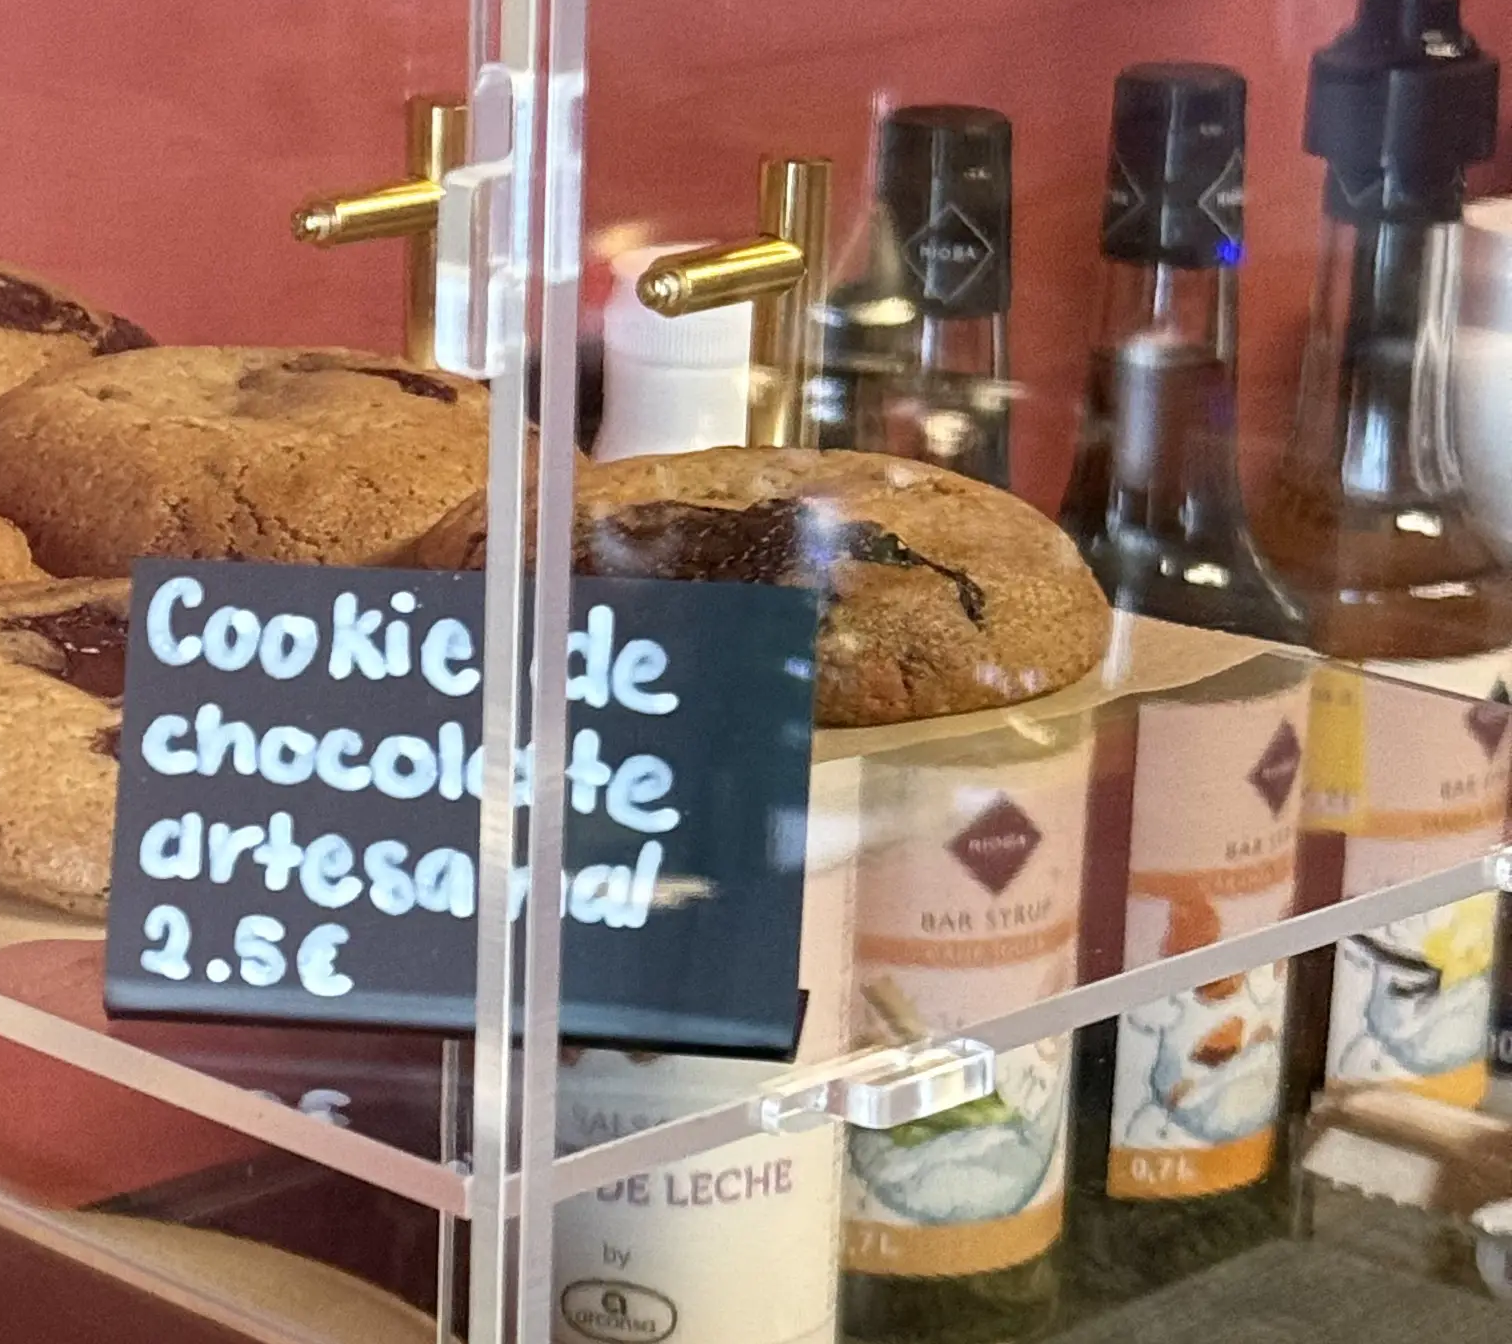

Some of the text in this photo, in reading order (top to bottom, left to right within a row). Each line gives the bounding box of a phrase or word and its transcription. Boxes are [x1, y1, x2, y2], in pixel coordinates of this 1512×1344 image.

[529, 604, 679, 715] de
[920, 910, 974, 933] BAR
[139, 904, 355, 998] 2.5€
[664, 1158, 793, 1207] LECHE
[601, 1240, 631, 1271] by
